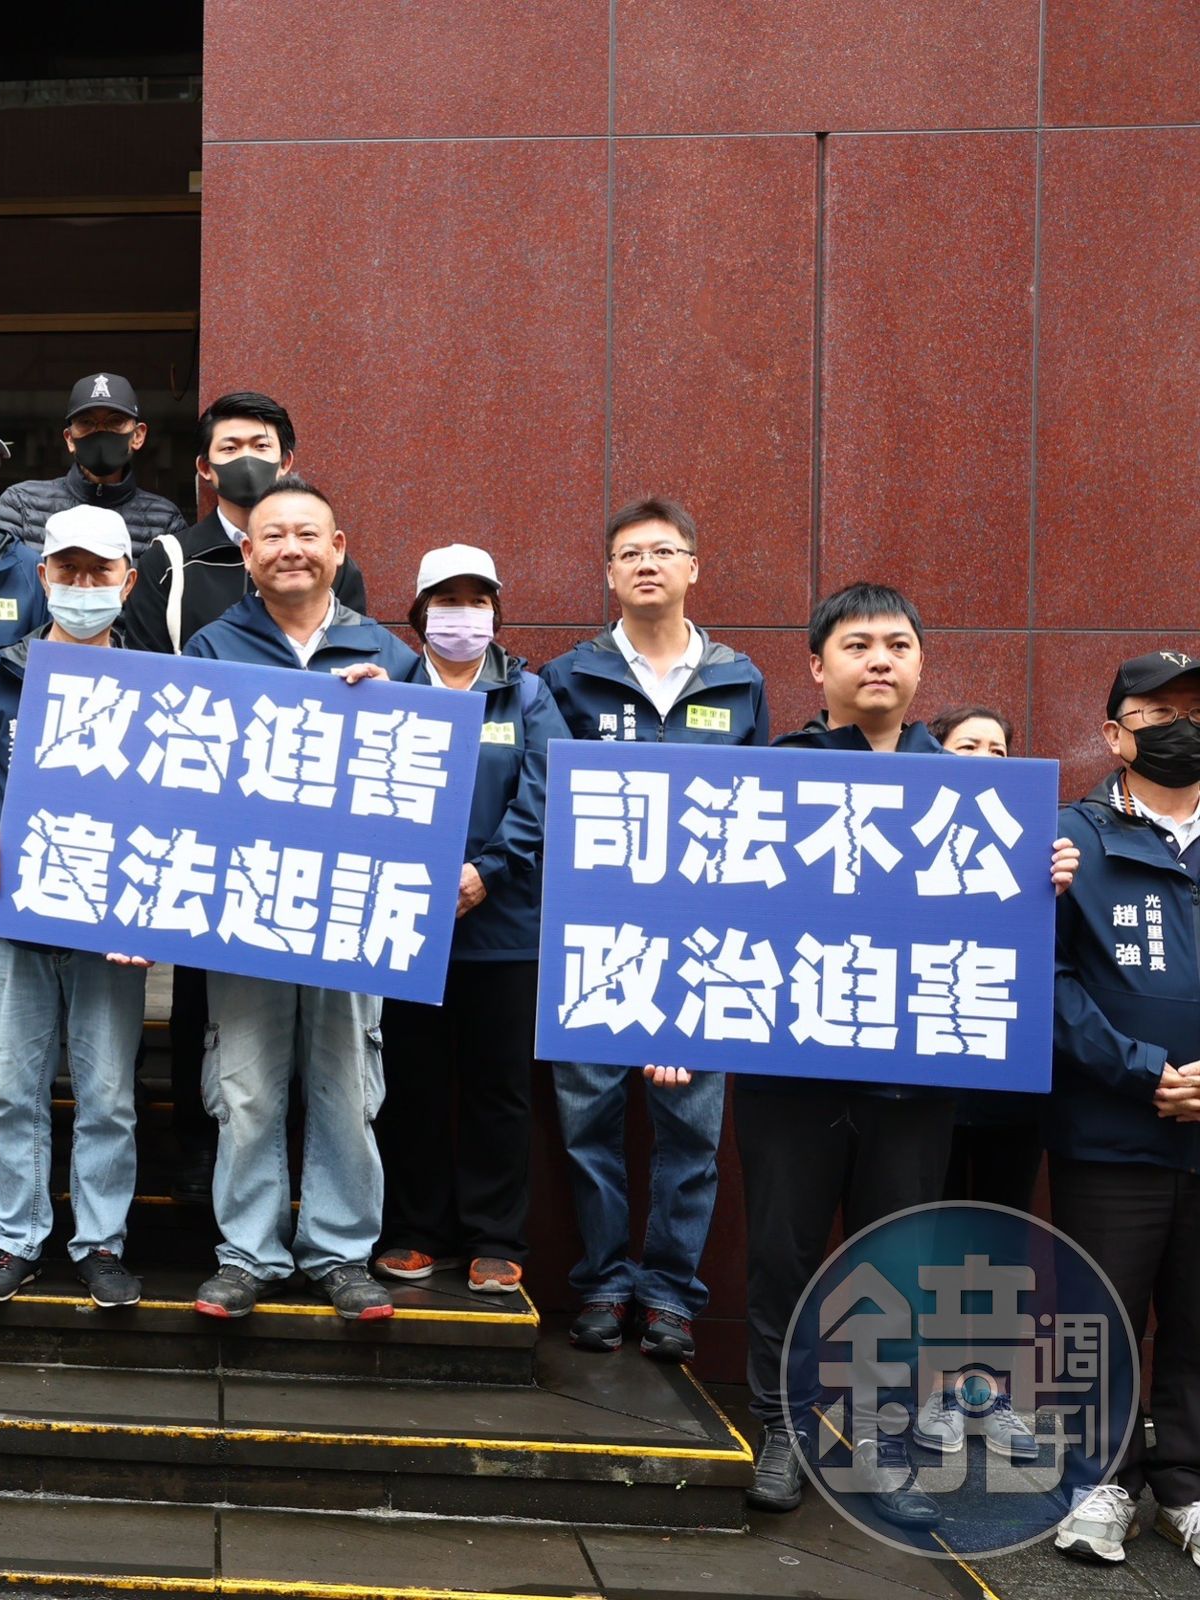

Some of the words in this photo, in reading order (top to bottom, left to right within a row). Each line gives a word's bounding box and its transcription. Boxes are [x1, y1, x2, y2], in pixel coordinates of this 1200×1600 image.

[35, 672, 453, 825] 政治迫害
[11, 808, 433, 971] 違法起訴
[569, 769, 1025, 902] 司法不公
[558, 922, 1019, 1060] 政治迫害
[1113, 904, 1142, 966] 趙強
[1145, 894, 1166, 971] 光明里里長
